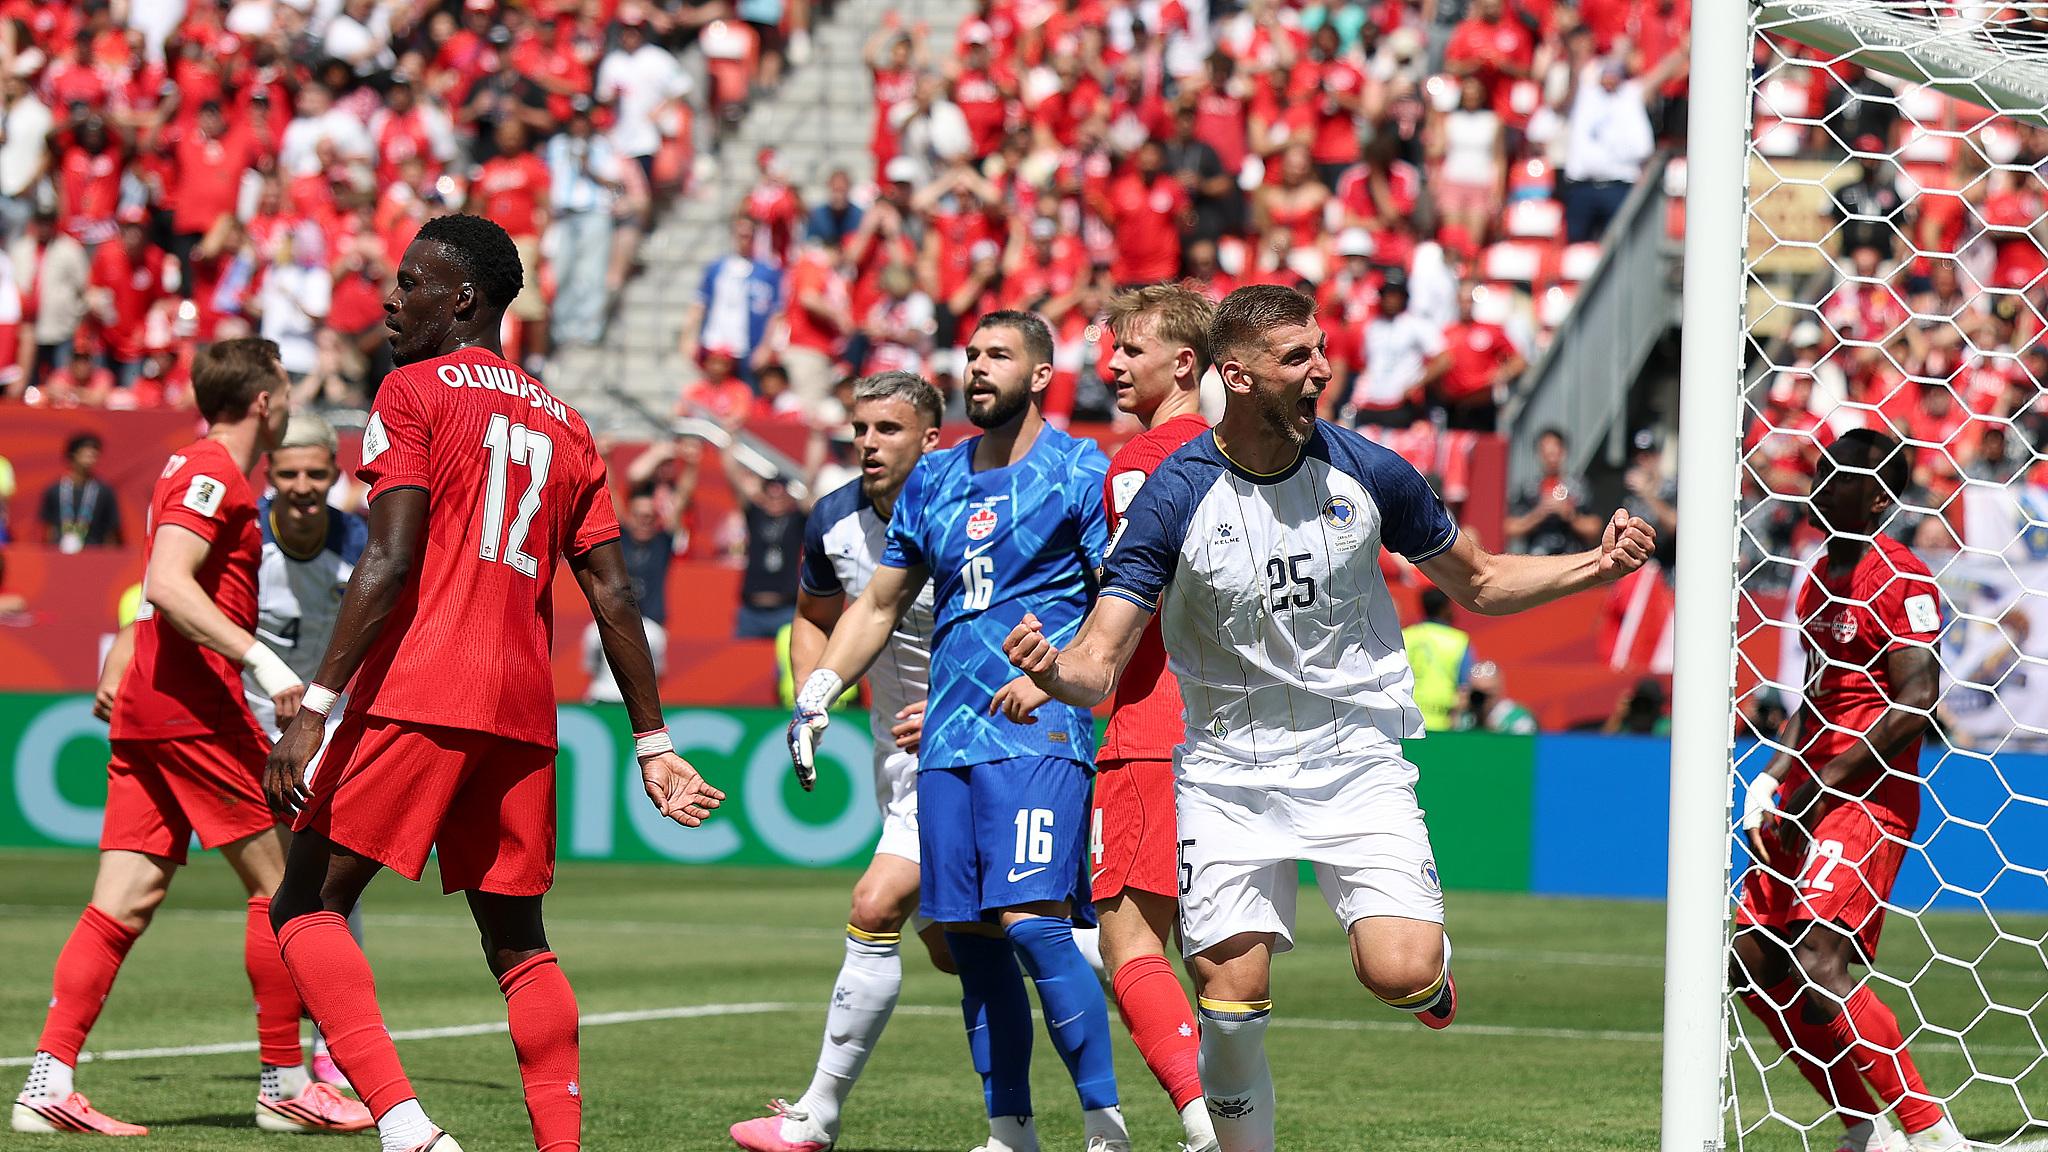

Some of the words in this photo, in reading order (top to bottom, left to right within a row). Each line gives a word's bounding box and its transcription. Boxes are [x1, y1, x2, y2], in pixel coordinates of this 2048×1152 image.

[479, 413, 553, 579] 12
[1214, 537, 1240, 545] KELME
[961, 556, 994, 610] 16
[1266, 553, 1317, 613] 25
[280, 617, 300, 649] 4
[1014, 808, 1054, 864] 16
[1091, 808, 1105, 865] 4
[1177, 839, 1196, 897] 5
